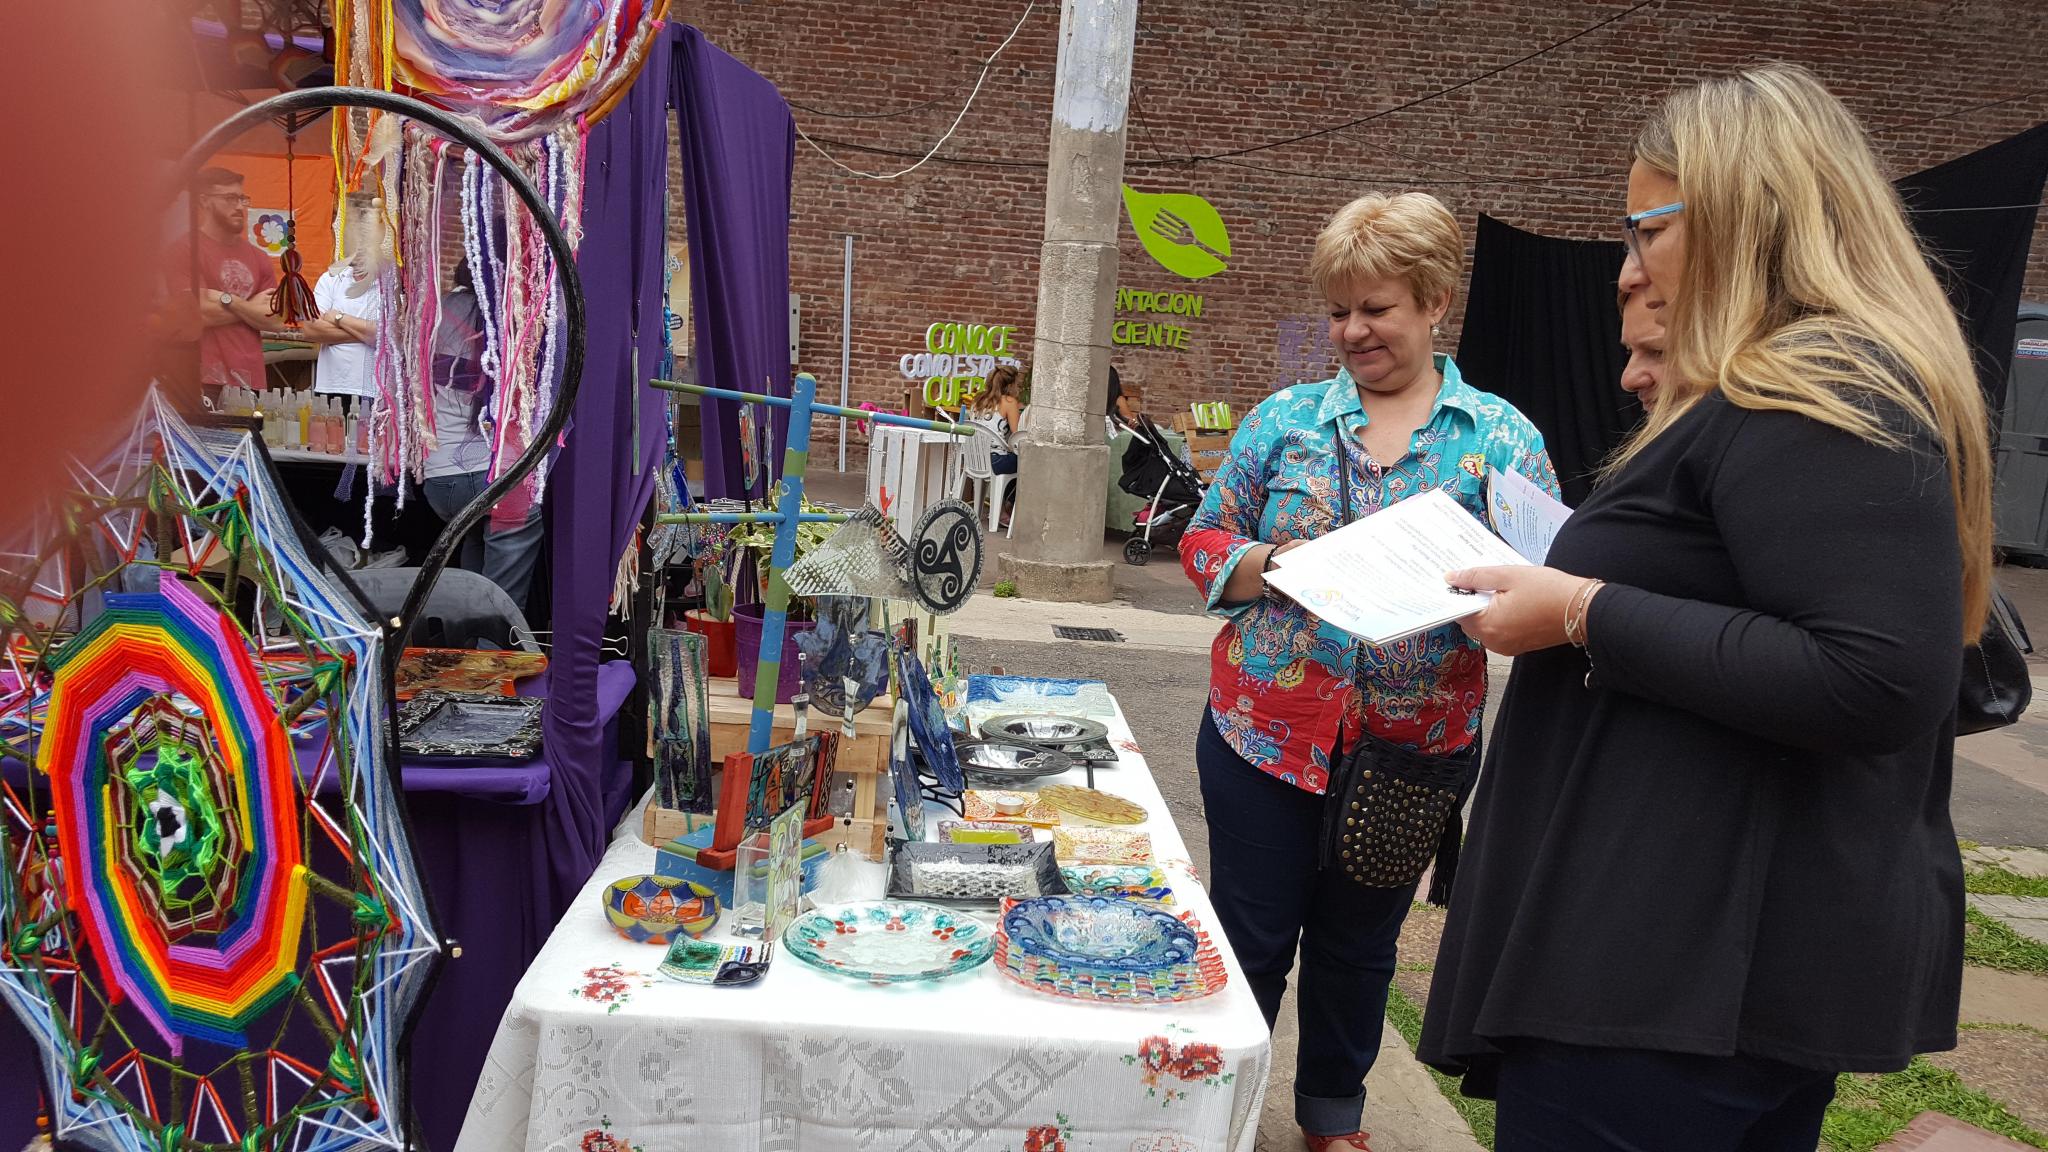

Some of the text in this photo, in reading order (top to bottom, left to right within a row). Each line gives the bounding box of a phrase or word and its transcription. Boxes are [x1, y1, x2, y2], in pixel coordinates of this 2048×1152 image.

[1115, 288, 1203, 317] NTACION
[926, 322, 1018, 357] CONOCE
[900, 353, 952, 378] COMO
[1190, 401, 1232, 430] VEN
